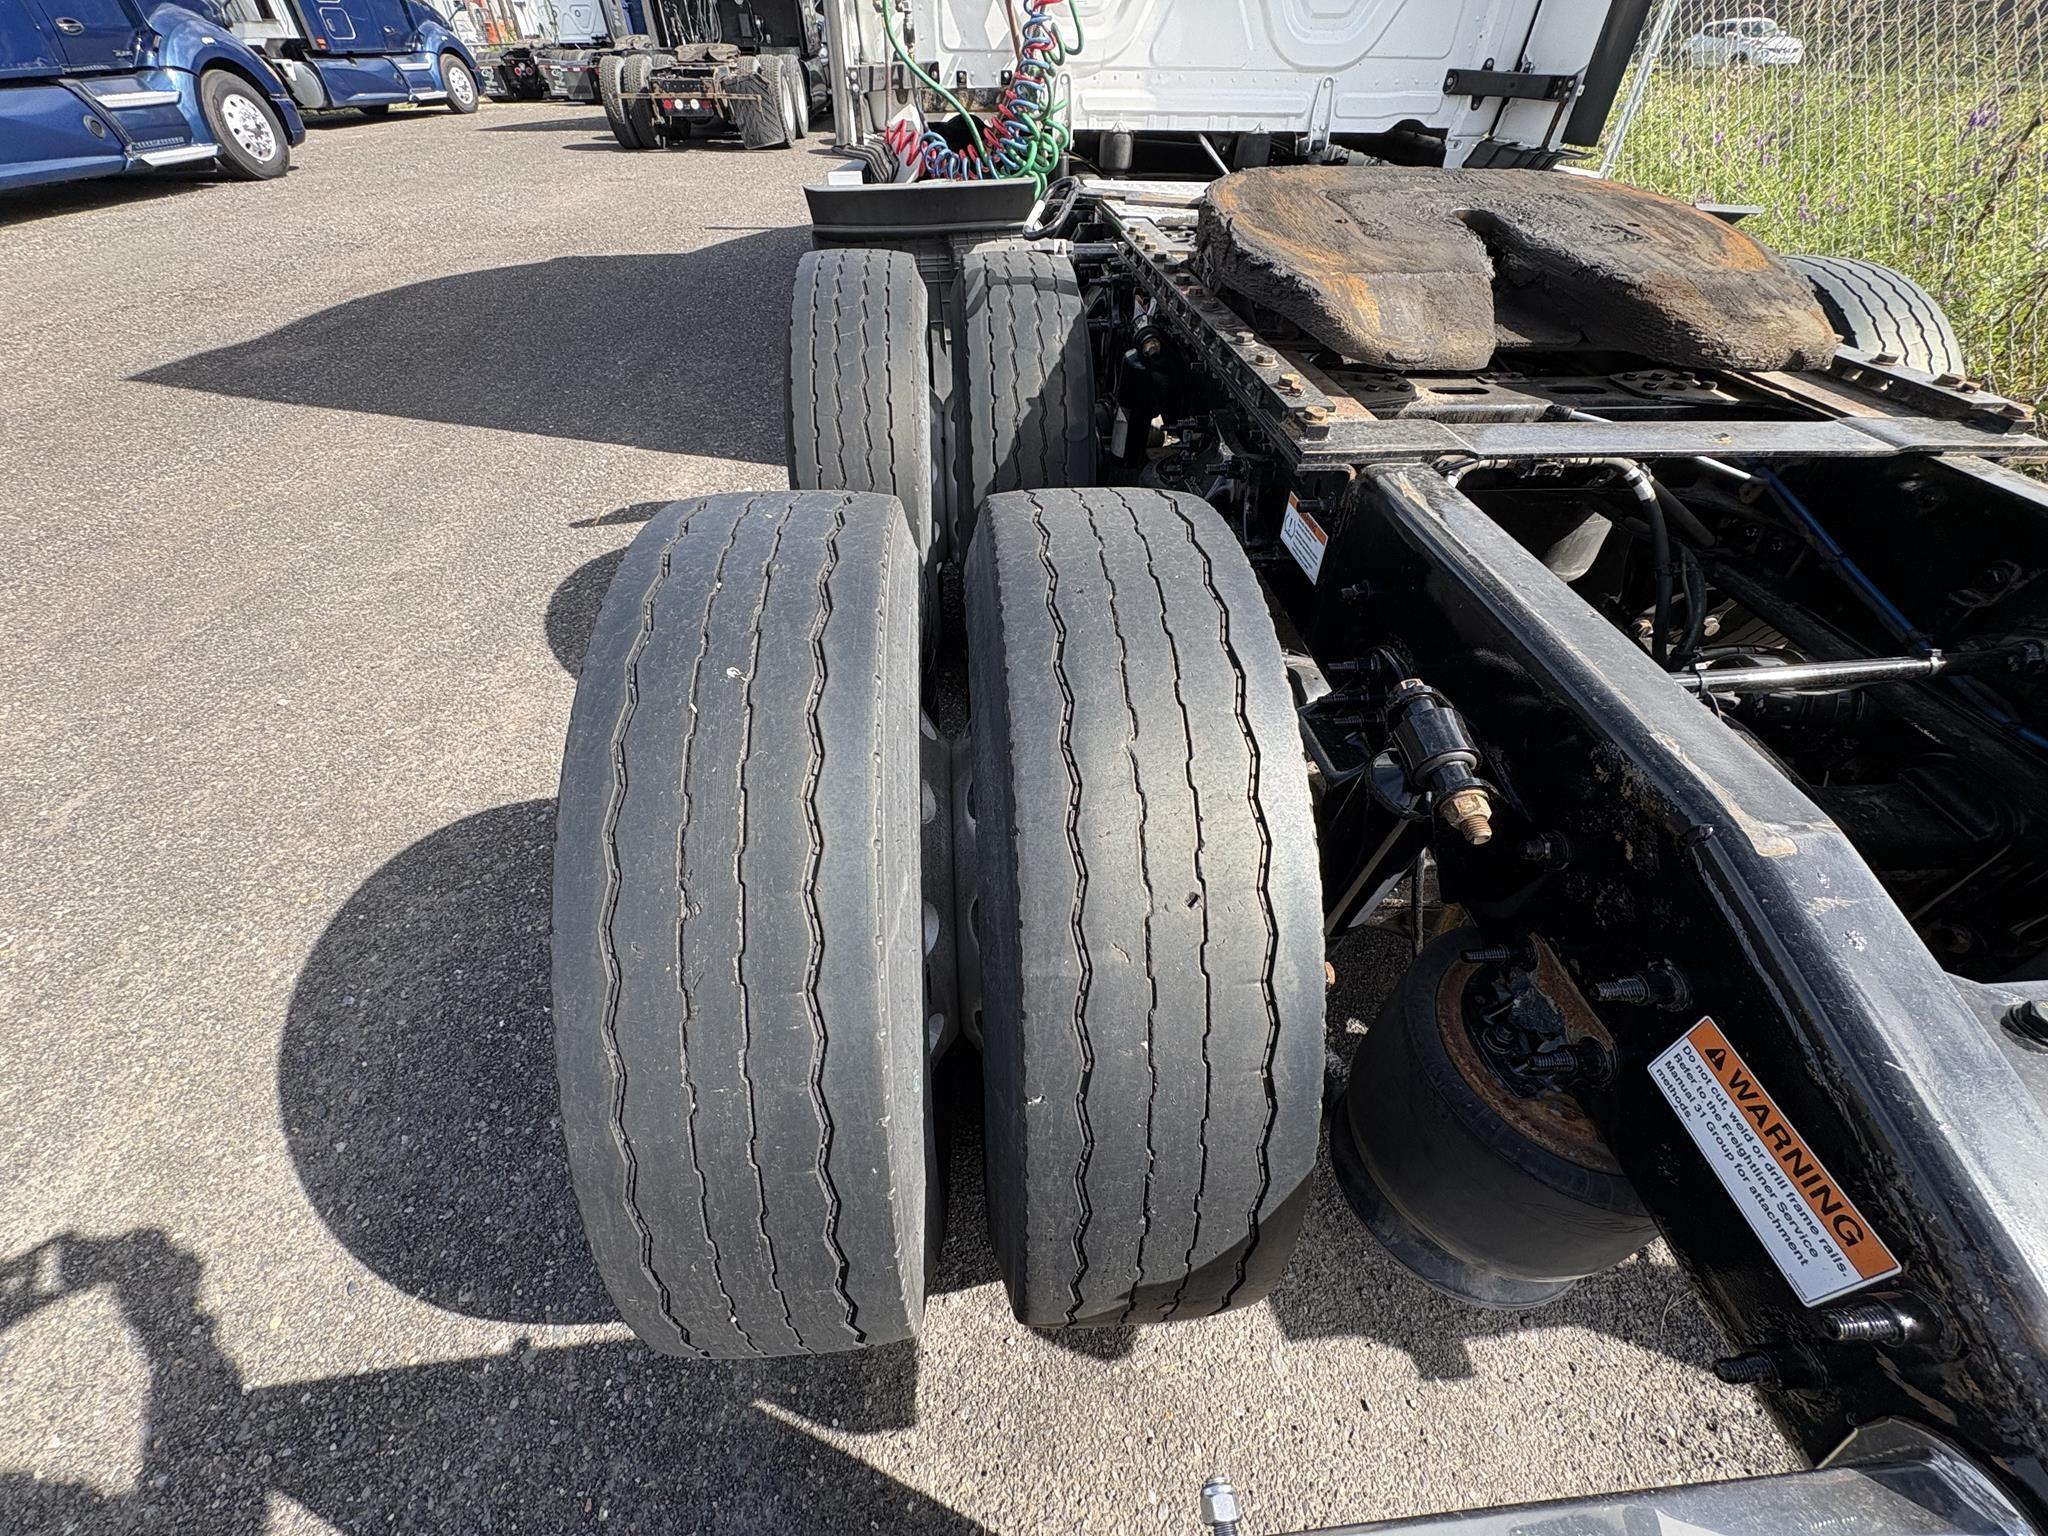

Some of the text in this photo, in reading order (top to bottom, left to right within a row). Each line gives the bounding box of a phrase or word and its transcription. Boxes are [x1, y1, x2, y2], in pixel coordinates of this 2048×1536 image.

[1656, 1068, 1691, 1121] methods.
[1664, 1060, 1696, 1103] Manual
[1693, 1103, 1707, 1118] 31
[1706, 1121, 1734, 1161] Group
[1734, 1162, 1751, 1182] for
[1748, 1185, 1809, 1266] attachment
[1673, 1052, 1697, 1083] Refer
[1696, 1085, 1706, 1099] to
[1706, 1100, 1722, 1122] the
[1721, 1122, 1778, 1198] Freightliner
[1776, 1201, 1818, 1258] Service
[1682, 1045, 1847, 1277] Do not cut, weld or drill frame rails.
[1728, 1068, 1864, 1247] WARNING
